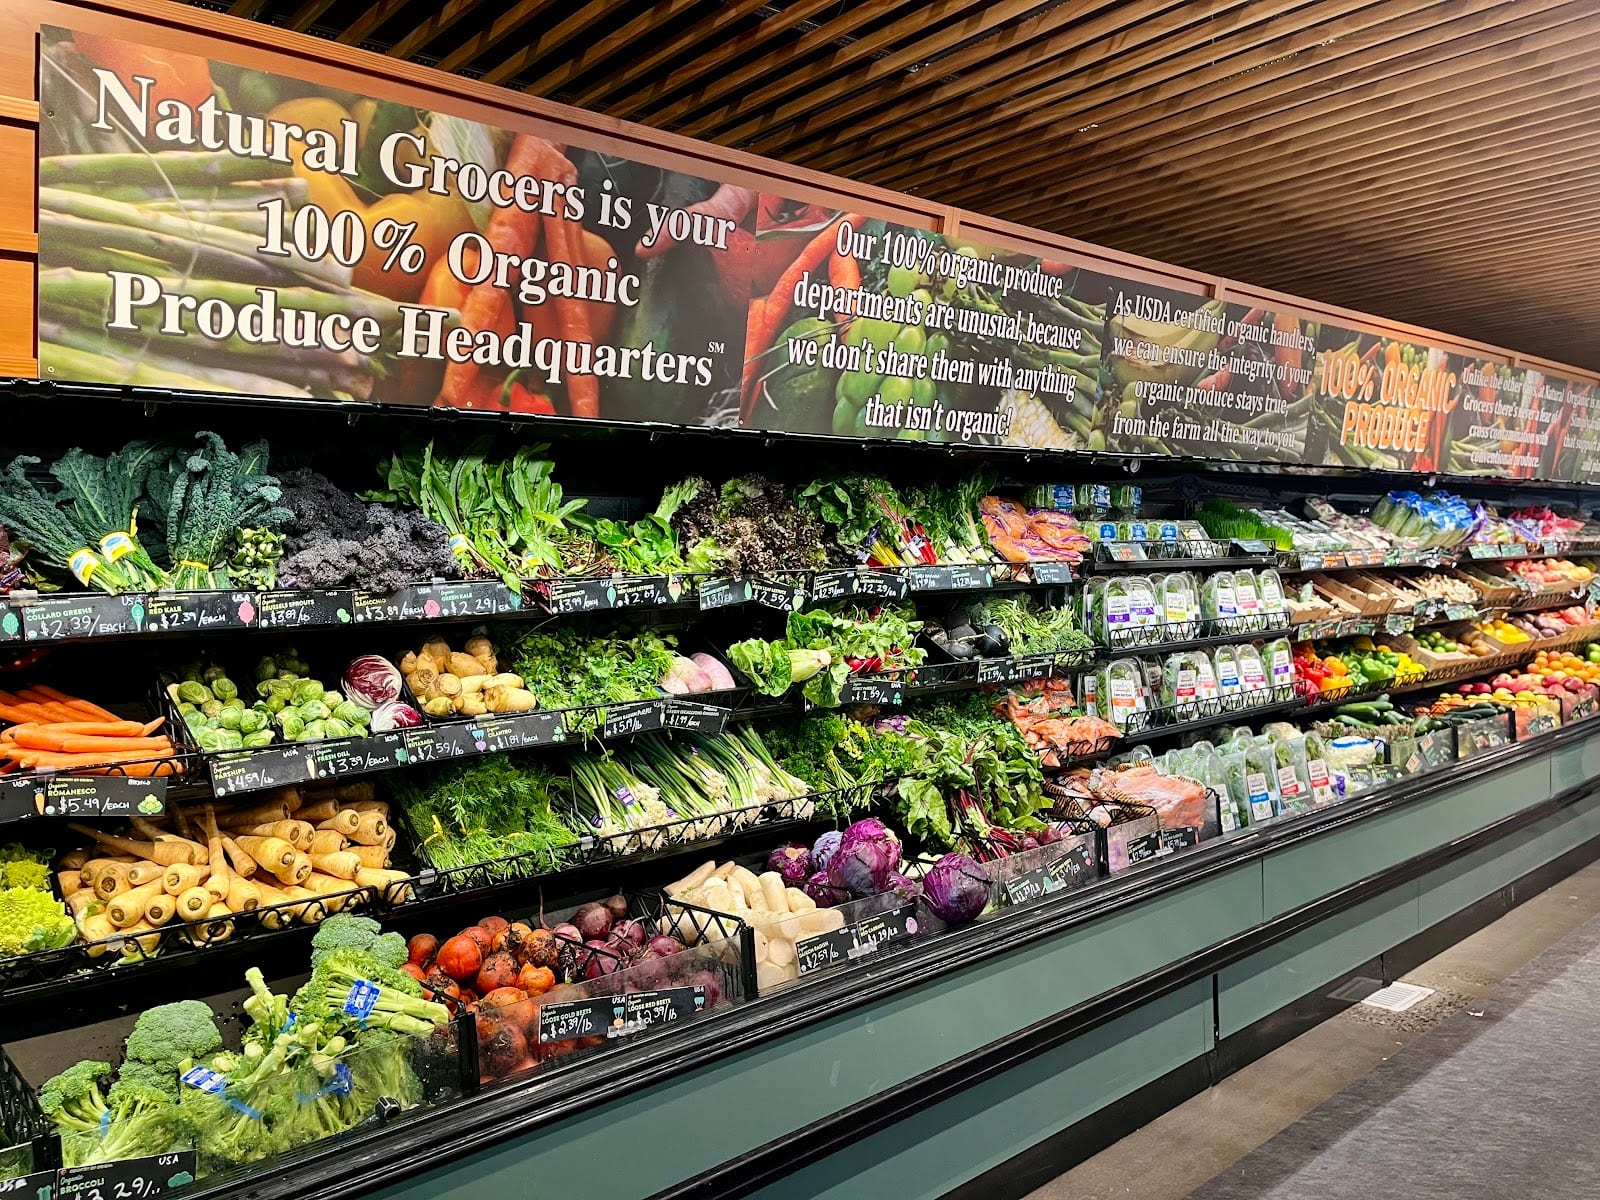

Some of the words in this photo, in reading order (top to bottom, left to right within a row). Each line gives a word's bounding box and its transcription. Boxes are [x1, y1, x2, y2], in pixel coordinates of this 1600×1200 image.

[92, 67, 359, 177] Natural
[378, 131, 587, 218] Grocers
[598, 179, 633, 229] is
[644, 200, 736, 251] your
[257, 199, 426, 275] 100%
[447, 231, 640, 307] Organic
[836, 221, 876, 257] Our
[882, 230, 935, 275] 100%
[940, 249, 1001, 289] organic
[1002, 261, 1063, 299] produce
[794, 272, 922, 325] departments
[926, 301, 954, 330] are
[958, 306, 1025, 345] unusual,
[1027, 313, 1082, 350] because
[1113, 291, 1132, 316] As
[1134, 294, 1171, 325] USDA
[1173, 307, 1226, 336] certified
[1227, 319, 1269, 345] organic
[1270, 324, 1316, 354] handlers,
[106, 270, 381, 355] Produce
[398, 306, 714, 386] Headquarters
[788, 338, 816, 366] we
[822, 334, 874, 373] don't
[877, 342, 928, 380] share
[931, 350, 975, 385] them
[978, 358, 1012, 389] with
[1015, 364, 1077, 402] anything
[1112, 337, 1133, 357] we
[1136, 340, 1160, 362] can
[1162, 346, 1205, 369] ensure
[1207, 349, 1228, 372] the
[1228, 352, 1276, 384] integrity
[1277, 361, 1289, 381] of
[1288, 367, 1312, 388] your
[1320, 349, 1375, 401] 100%
[1380, 360, 1460, 414] ORGANIC
[1463, 368, 1489, 387] Unlike
[1490, 373, 1503, 390] the
[1503, 376, 1522, 393] other
[1134, 379, 1184, 405] organic
[1184, 384, 1235, 409] produce
[1236, 391, 1263, 416] stays
[1264, 395, 1289, 417] true,
[1463, 395, 1494, 414] Grocers
[1494, 399, 1518, 418] there's
[865, 396, 903, 428] that
[905, 399, 945, 431] isn't
[945, 407, 1013, 441] organic!
[1340, 401, 1430, 453] PRODUCE
[1112, 411, 1146, 434] from
[1148, 414, 1169, 438] the
[1171, 416, 1201, 441] farm
[1202, 420, 1219, 443] all
[1220, 422, 1240, 444] the
[1242, 429, 1264, 450] way
[1264, 429, 1275, 447] to
[1275, 433, 1296, 452] you
[1469, 424, 1489, 439] cross
[121, 595, 144, 606] USA
[232, 594, 250, 602] USA
[27, 611, 61, 621] COLLARD
[63, 607, 92, 616] GREENS
[283, 749, 298, 758] USA
[215, 768, 246, 780] PARSNIPS
[48, 788, 96, 797] ROMANESCO
[612, 997, 626, 1005] USA
[628, 1003, 645, 1012] LOOSE
[645, 1001, 656, 1009] RED
[542, 1016, 560, 1025] LOOSE
[561, 1012, 575, 1020] GOLD
[159, 1155, 179, 1165] USA
[60, 1178, 104, 1195] BROCCOLI
